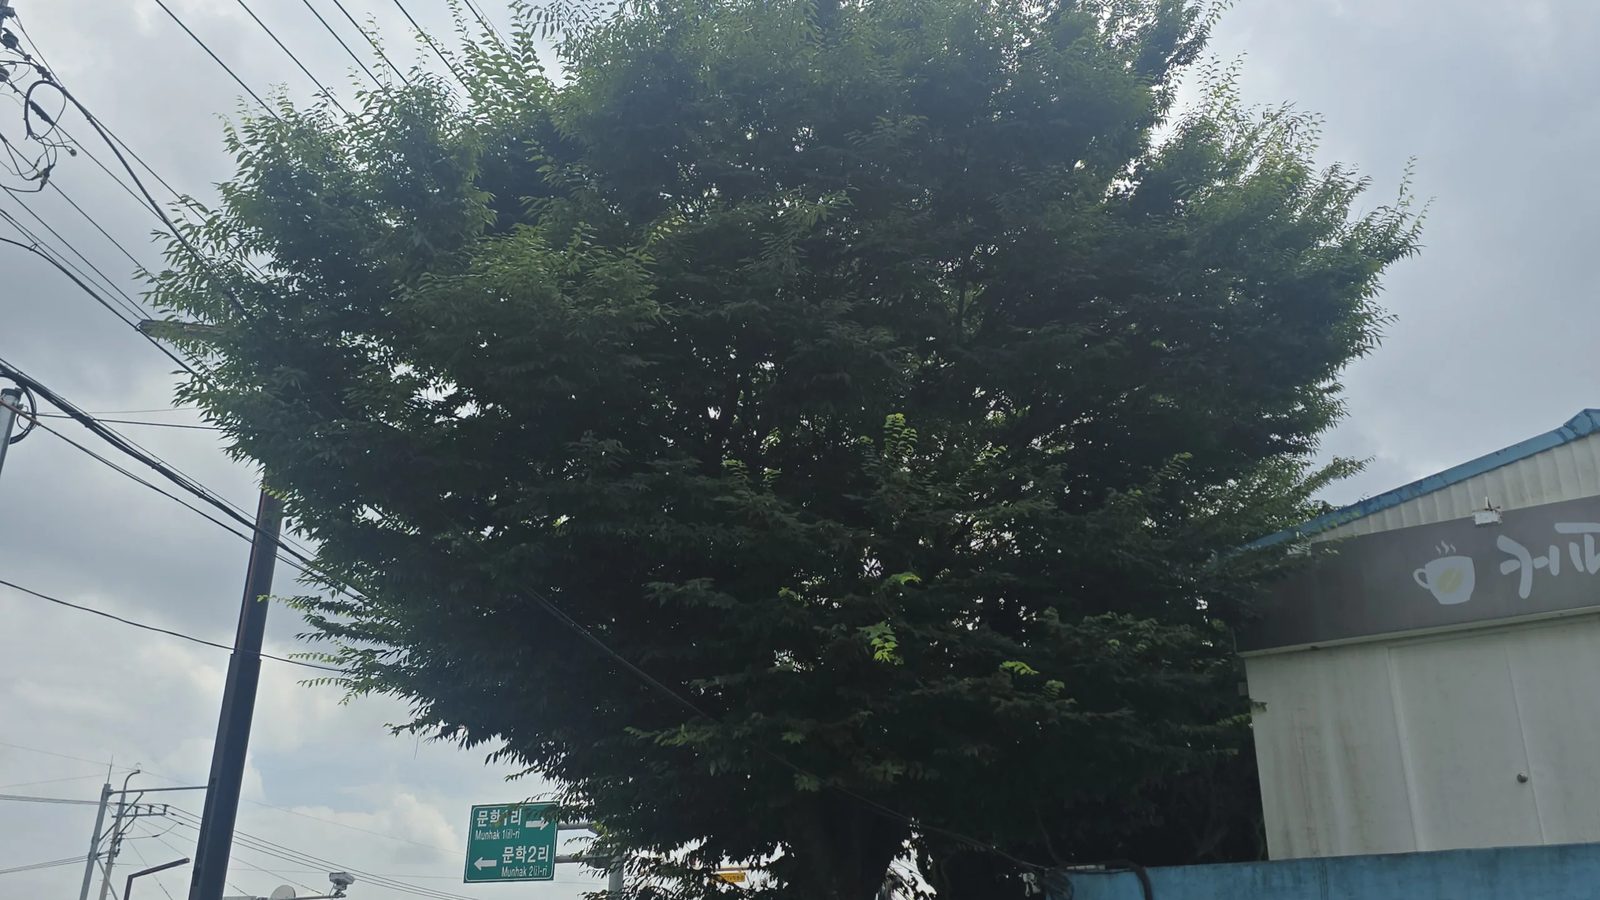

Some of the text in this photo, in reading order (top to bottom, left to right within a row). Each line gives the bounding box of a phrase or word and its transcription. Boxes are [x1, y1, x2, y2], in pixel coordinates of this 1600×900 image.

[475, 829, 500, 841] Munhak
[502, 845, 550, 864] 문학2리
[501, 866, 527, 877] Munhak
